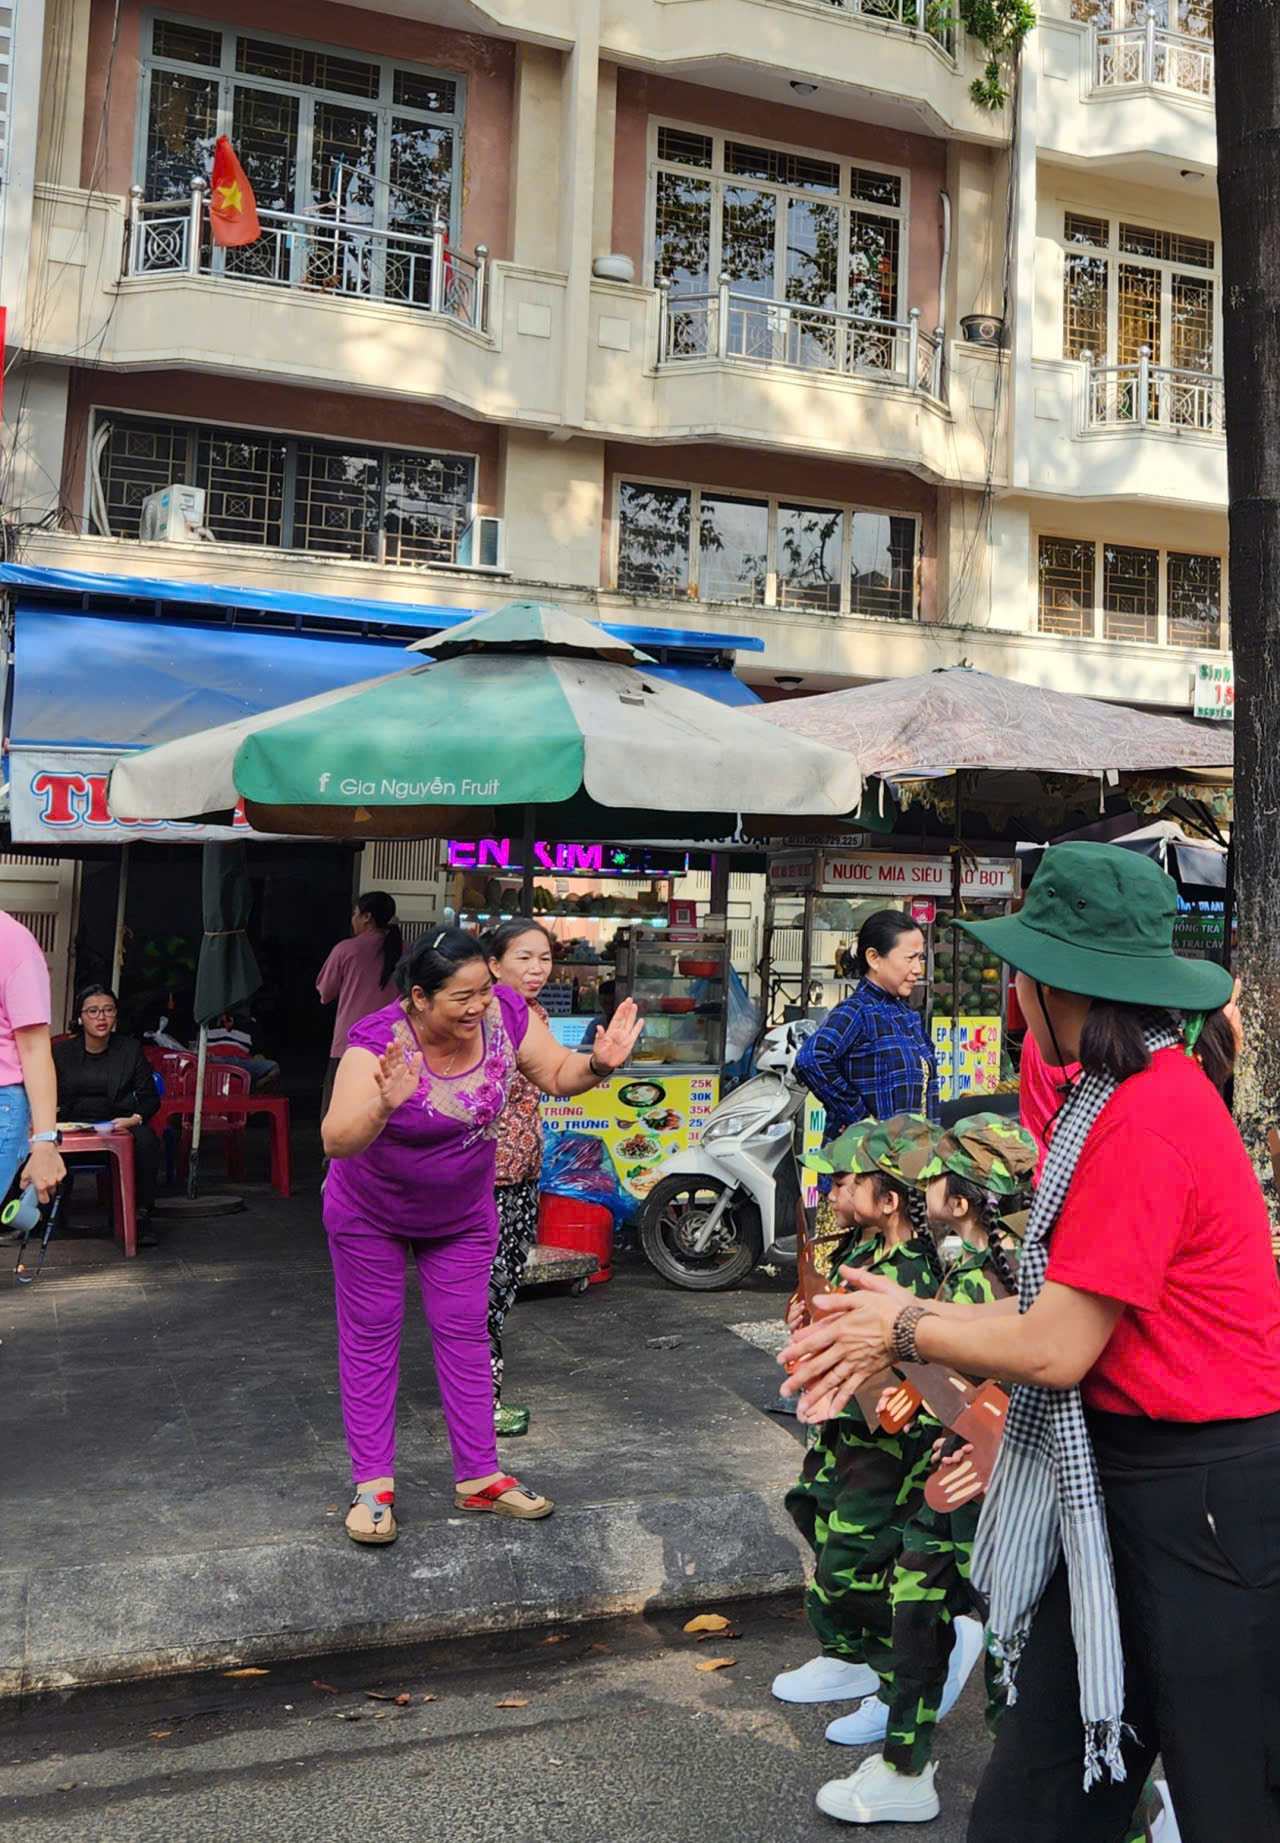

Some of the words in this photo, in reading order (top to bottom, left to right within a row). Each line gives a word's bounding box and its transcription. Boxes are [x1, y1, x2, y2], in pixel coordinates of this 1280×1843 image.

[340, 779, 375, 795] Gia
[381, 776, 455, 798] Nguyễn
[461, 779, 499, 795] Fruit
[833, 863, 872, 880] NƯỚC
[878, 864, 906, 882] MÍA
[912, 866, 942, 883] SIÊU
[988, 1027, 997, 1041] 20
[691, 1079, 712, 1088] 25K
[690, 1092, 712, 1101] 30K
[689, 1105, 712, 1114] 35K
